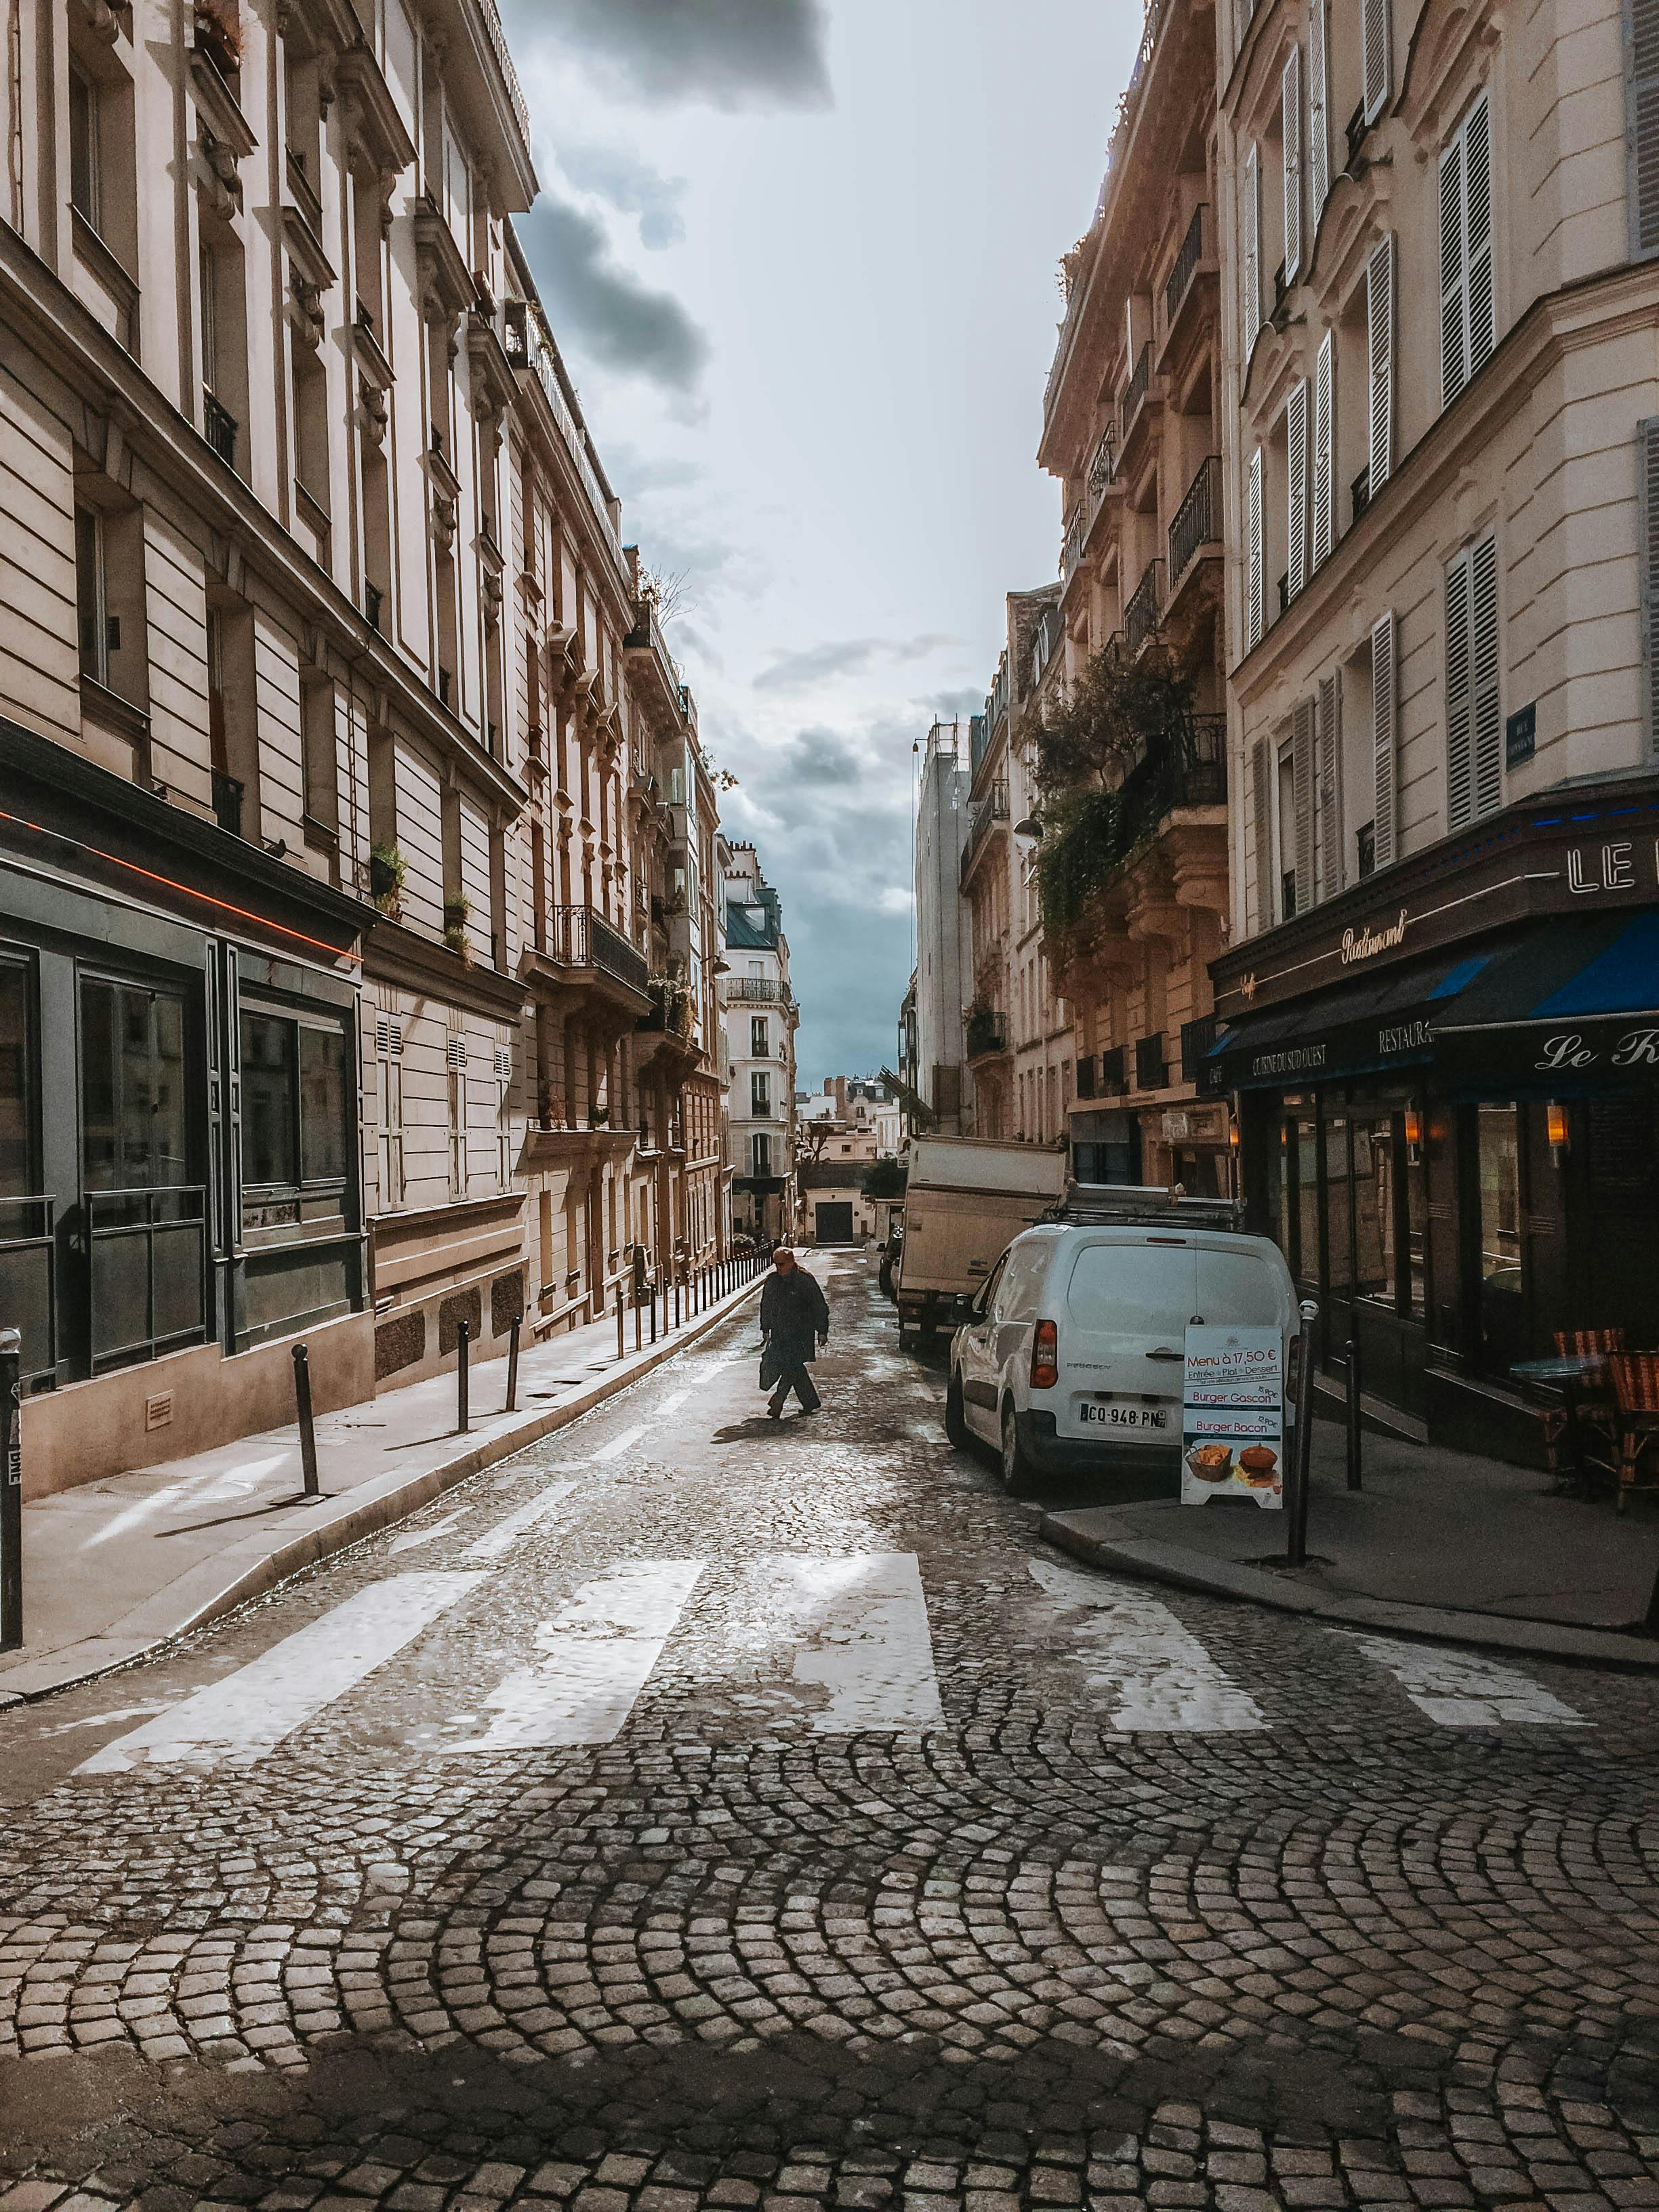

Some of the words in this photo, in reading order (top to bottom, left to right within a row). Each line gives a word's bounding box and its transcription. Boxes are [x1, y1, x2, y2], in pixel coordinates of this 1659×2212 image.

[1567, 842, 1635, 894] LE
[1287, 1049, 1301, 1071] SUD
[1302, 1044, 1326, 1069] OUEST
[1534, 1035, 1601, 1070] Le
[1187, 1356, 1220, 1368] Menu
[1222, 1353, 1231, 1365] à
[1233, 1351, 1265, 1365] 17,50
[1188, 1368, 1215, 1379] Entrée
[1222, 1368, 1237, 1376] Plat
[1245, 1364, 1277, 1374] Dessert
[1193, 1391, 1227, 1404] Burger
[1230, 1393, 1271, 1404] Gascon
[1196, 1420, 1233, 1433] Burger
[1233, 1422, 1267, 1433] Bacon
